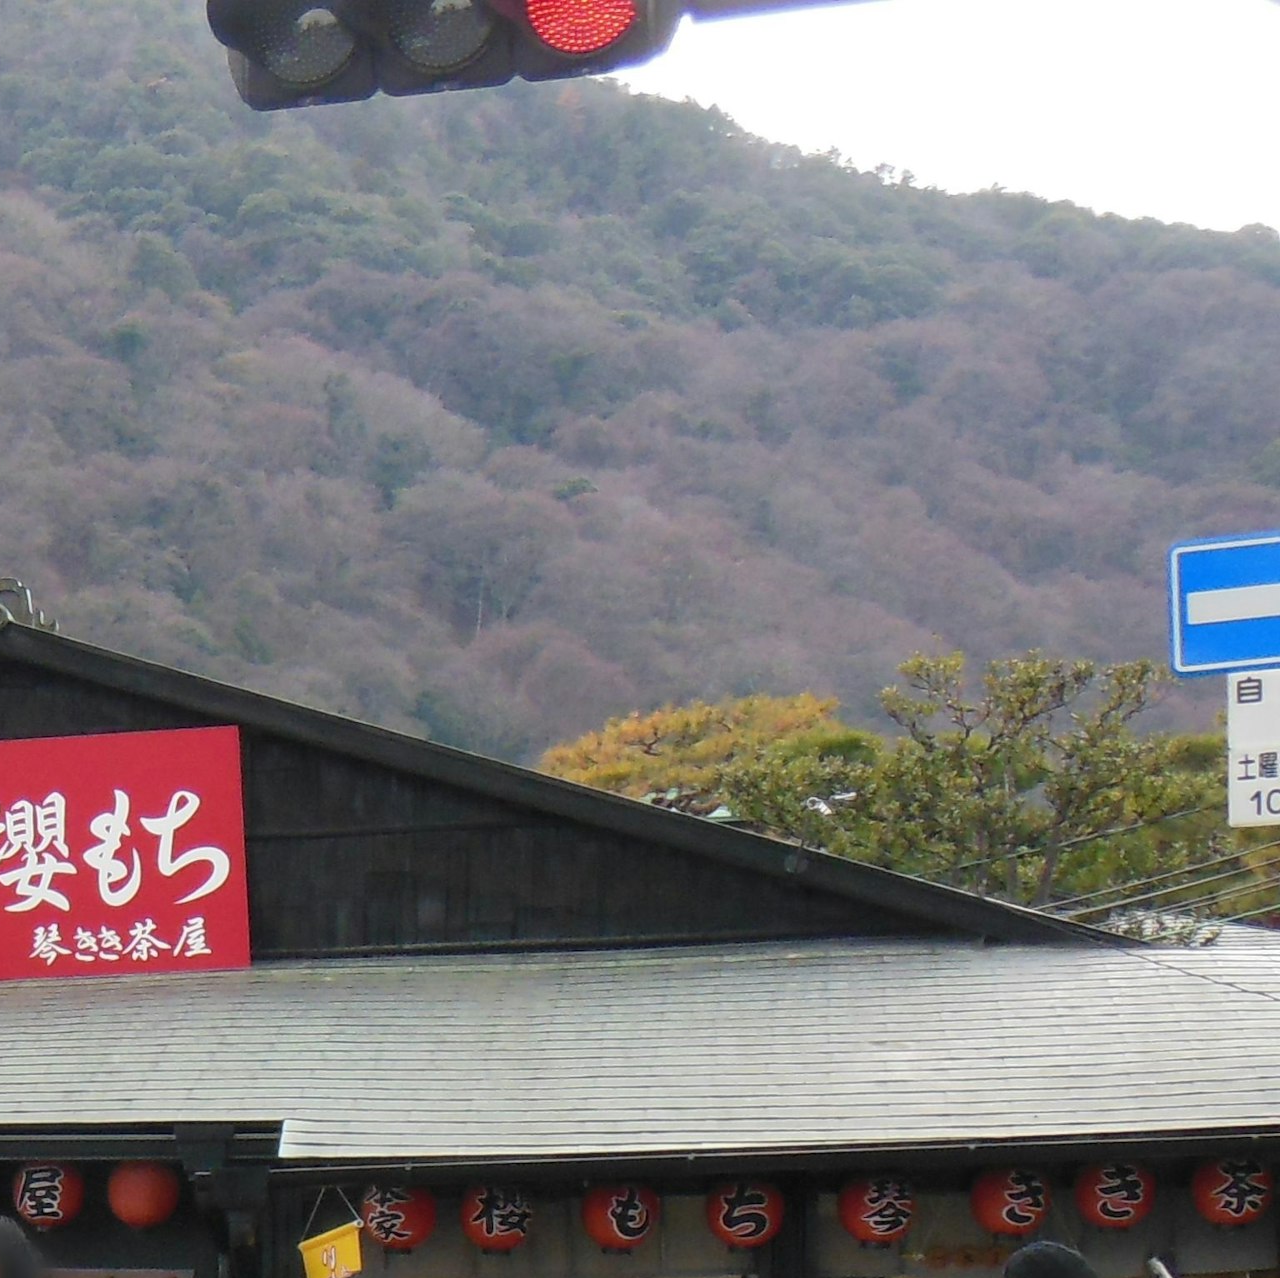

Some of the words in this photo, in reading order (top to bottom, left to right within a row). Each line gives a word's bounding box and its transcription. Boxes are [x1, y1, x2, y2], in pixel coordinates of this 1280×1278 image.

[1237, 676, 1262, 704] 自
[29, 917, 213, 967] 琴きき茶屋
[16, 1167, 65, 1219] 屋
[608, 1184, 651, 1240] も
[720, 1184, 769, 1241] ち
[1001, 1170, 1045, 1227] き
[1095, 1164, 1144, 1221] き
[1210, 1160, 1269, 1218] 茶
